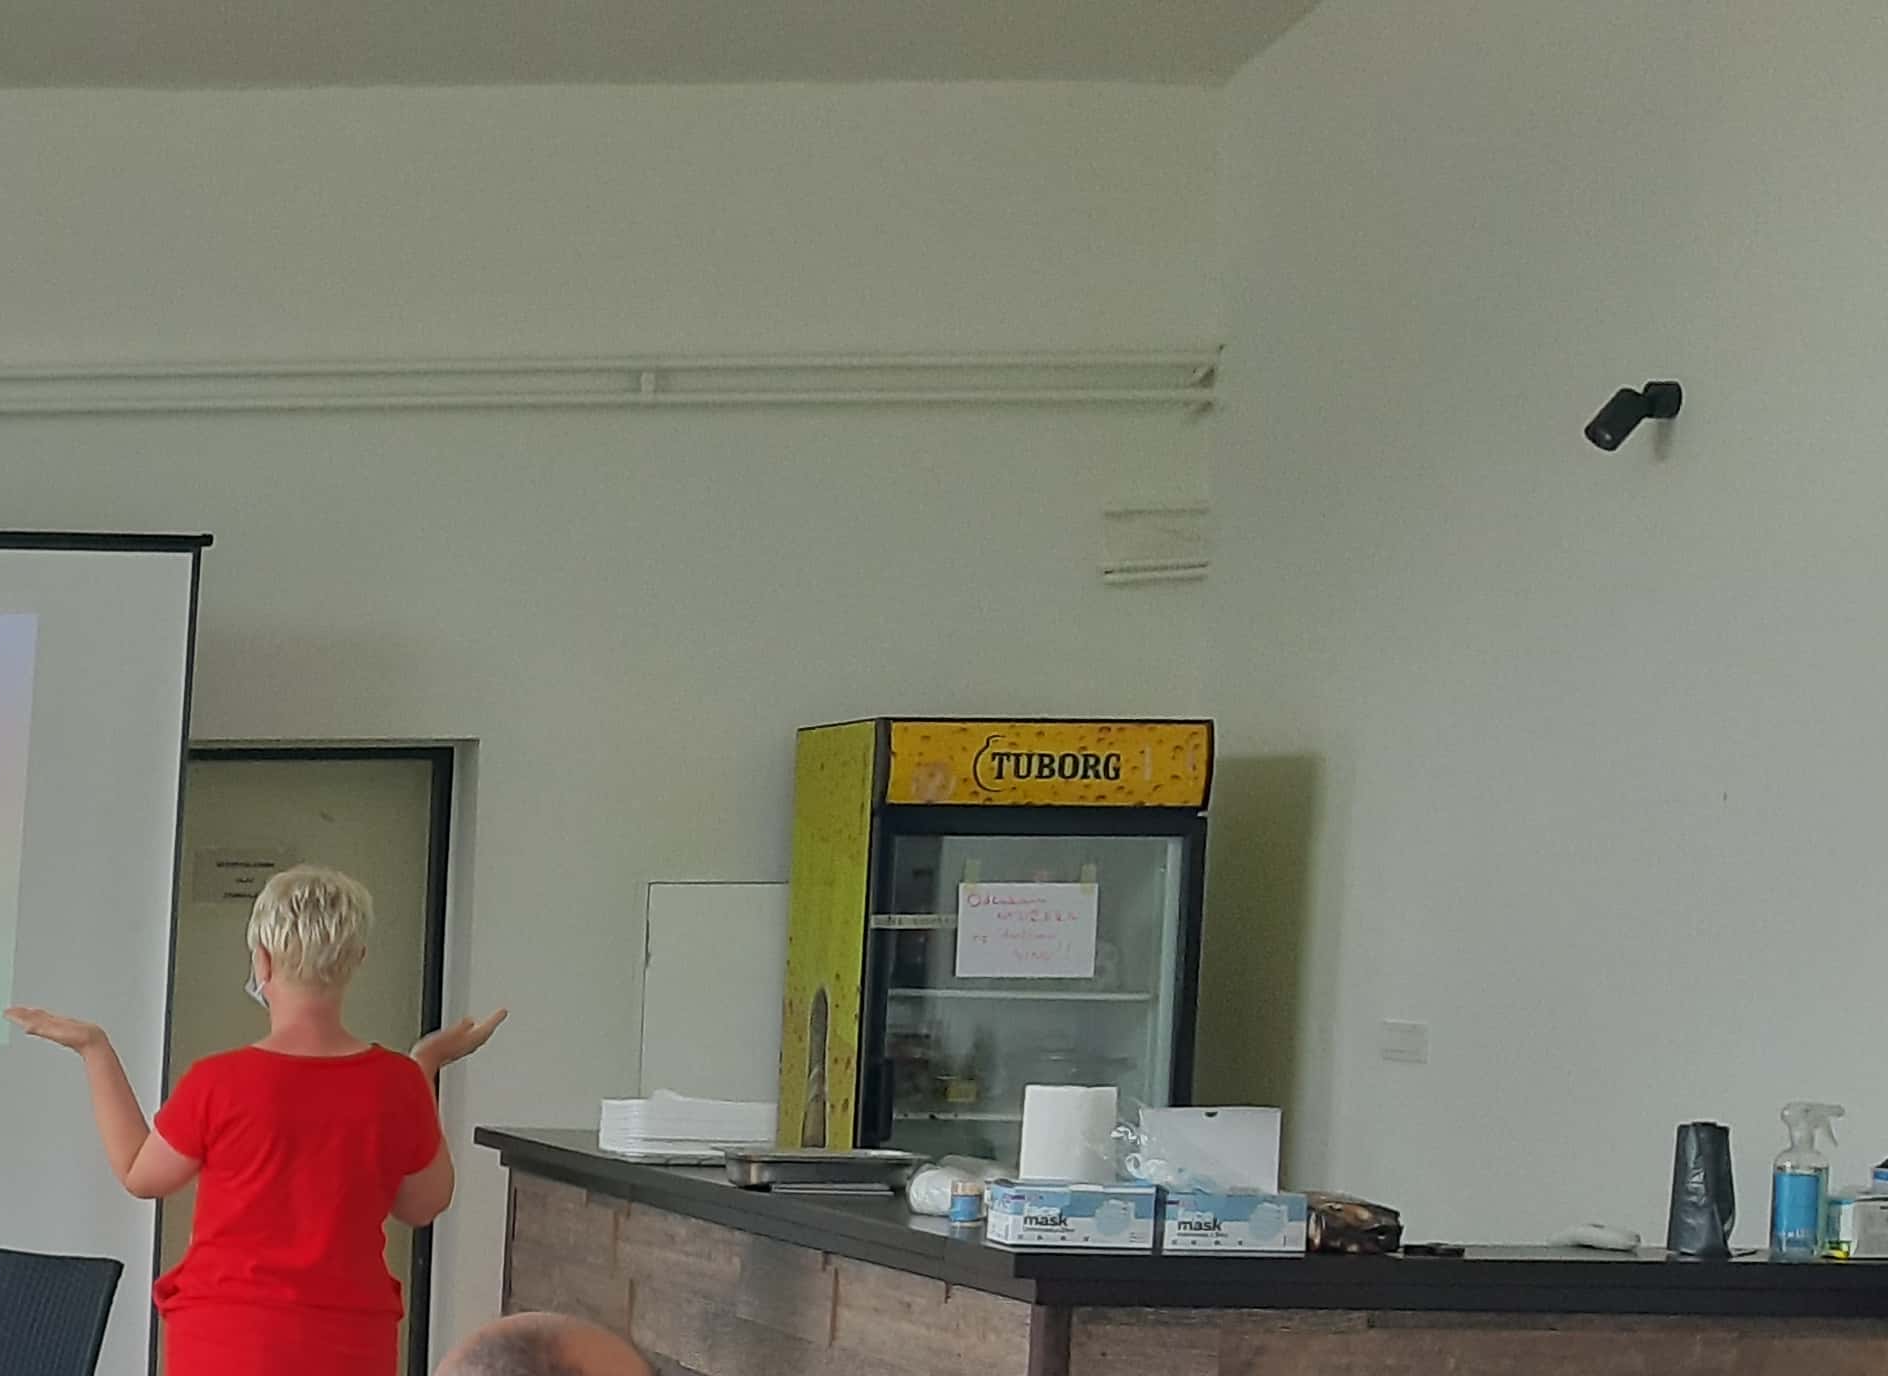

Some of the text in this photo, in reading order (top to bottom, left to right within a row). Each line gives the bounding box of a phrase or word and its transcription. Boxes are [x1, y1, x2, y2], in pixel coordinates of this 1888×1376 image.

[992, 752, 1121, 780] TUBORG
[1024, 1212, 1068, 1227] mask
[1177, 1217, 1222, 1231] mask
